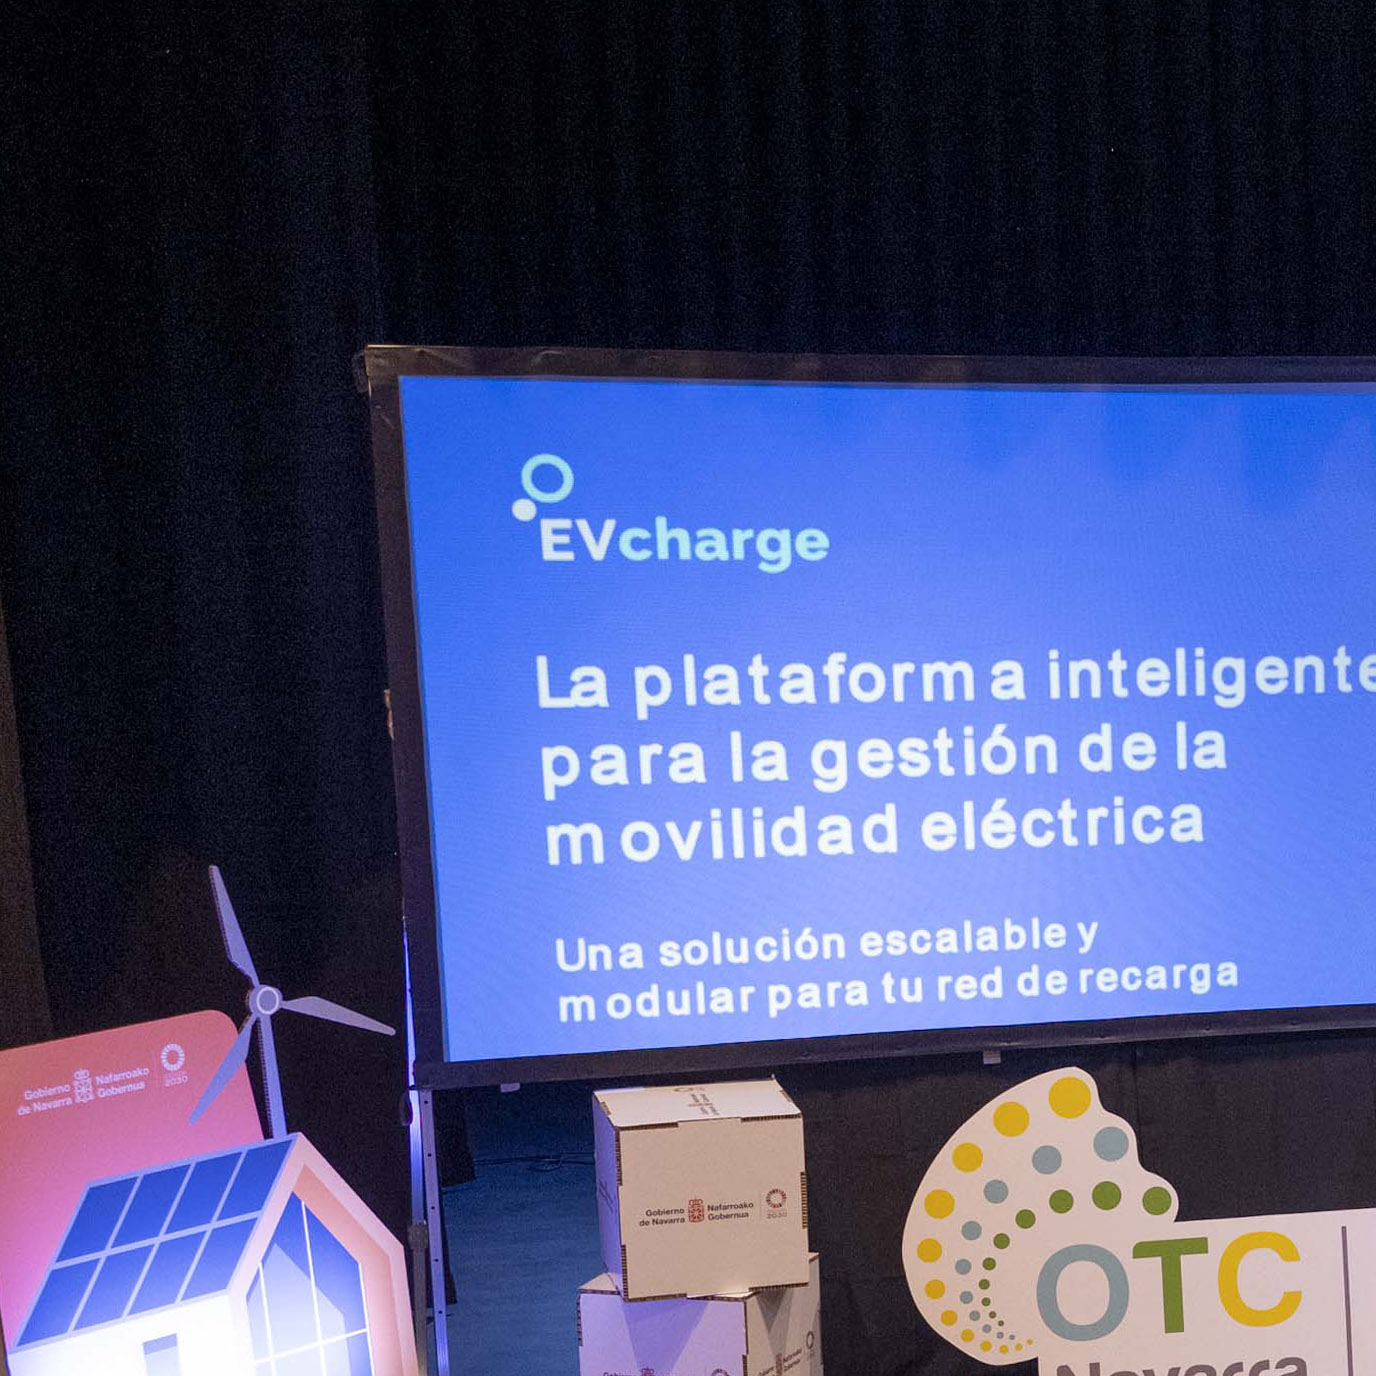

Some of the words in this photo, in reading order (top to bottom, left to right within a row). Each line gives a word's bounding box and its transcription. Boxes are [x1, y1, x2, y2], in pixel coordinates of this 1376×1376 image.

[539, 515, 831, 574] EVcharge
[535, 654, 611, 709] La
[540, 741, 708, 802] para
[729, 729, 791, 784] la
[809, 722, 1059, 795] gestión
[1077, 721, 1158, 774] de
[1175, 720, 1228, 771] la
[919, 796, 1205, 853] eléctrica
[554, 936, 646, 973] Una
[657, 924, 850, 969] solución
[857, 914, 1068, 960] escalable
[1075, 920, 1100, 956] y
[766, 978, 871, 1021] para
[880, 969, 926, 1006] tu
[934, 963, 1005, 1004] red
[1015, 962, 1070, 999] de
[1077, 960, 1239, 996] recarga
[639, 1219, 650, 1227] de
[652, 1216, 686, 1226] Navarra
[645, 1208, 685, 1217] Gobierno
[707, 1201, 754, 1212] Nafarroako
[707, 1212, 750, 1221] Gobernua
[1036, 1230, 1304, 1342] OTC
